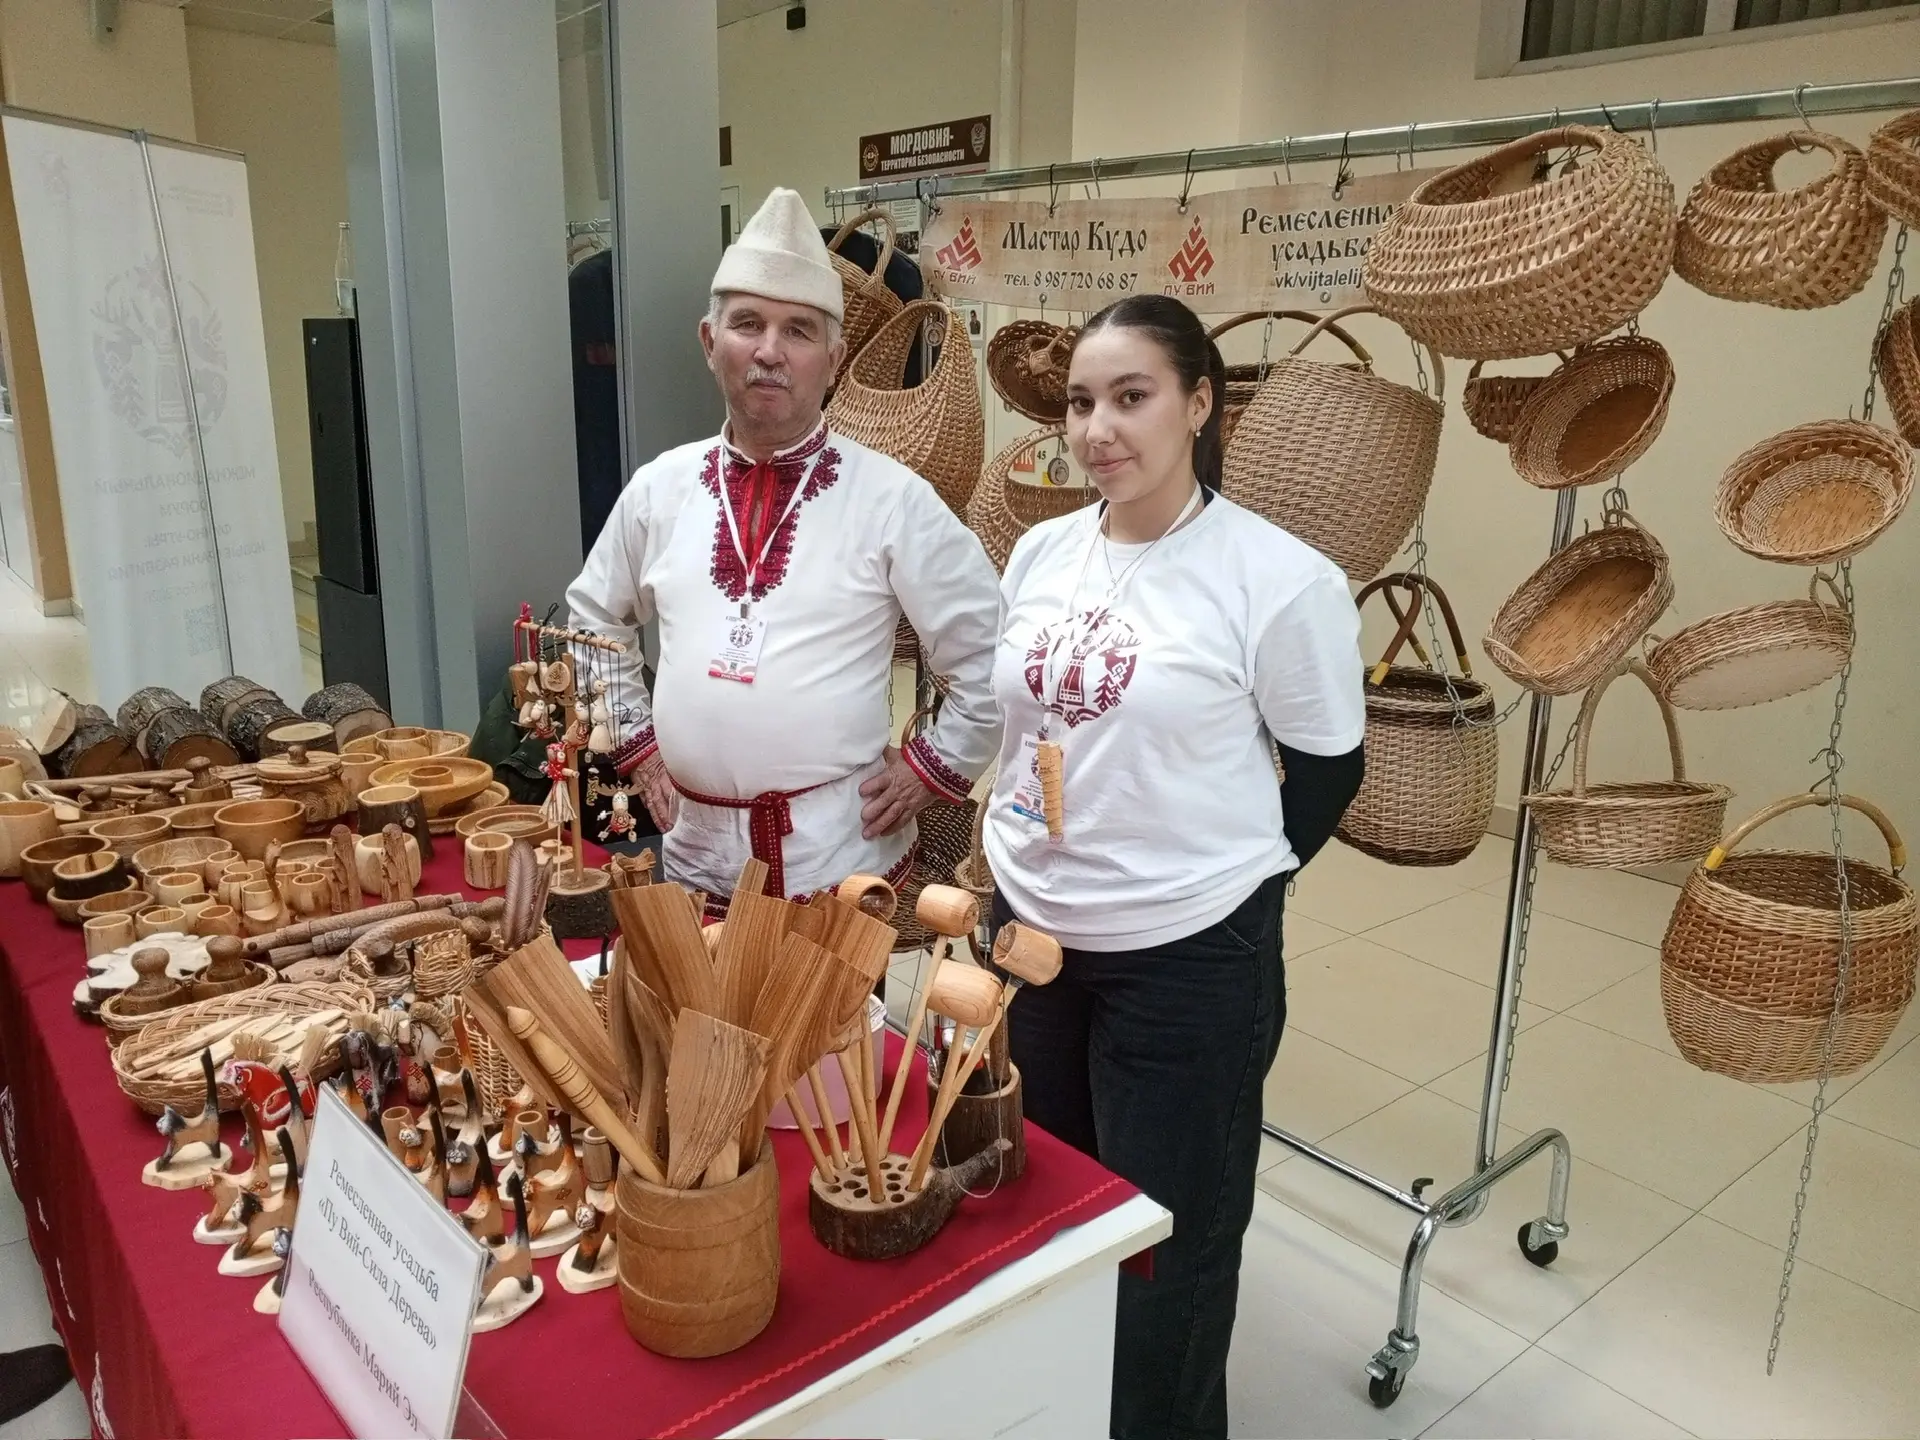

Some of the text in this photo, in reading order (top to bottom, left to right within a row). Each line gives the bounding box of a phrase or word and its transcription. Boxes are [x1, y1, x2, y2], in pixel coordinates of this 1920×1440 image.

[890, 126, 954, 155] МОРДОВИЯ-
[881, 149, 965, 172] ТЕРРИТОРИЯ БЕЗОПАСНОСТИ
[1240, 204, 1394, 235] Ремесленна
[1002, 220, 1148, 261] Мастар Кудо
[1003, 270, 1138, 292] тел. 8 987 720 68 87
[1163, 281, 1215, 296] ПУ ВИЙ
[1036, 450, 1047, 461] 45
[330, 1159, 439, 1302] Ремесленная усадьба
[318, 1196, 437, 1350] «Пу Вий-Сила Дерева»
[308, 1268, 418, 1433] Республика Марий Эл
